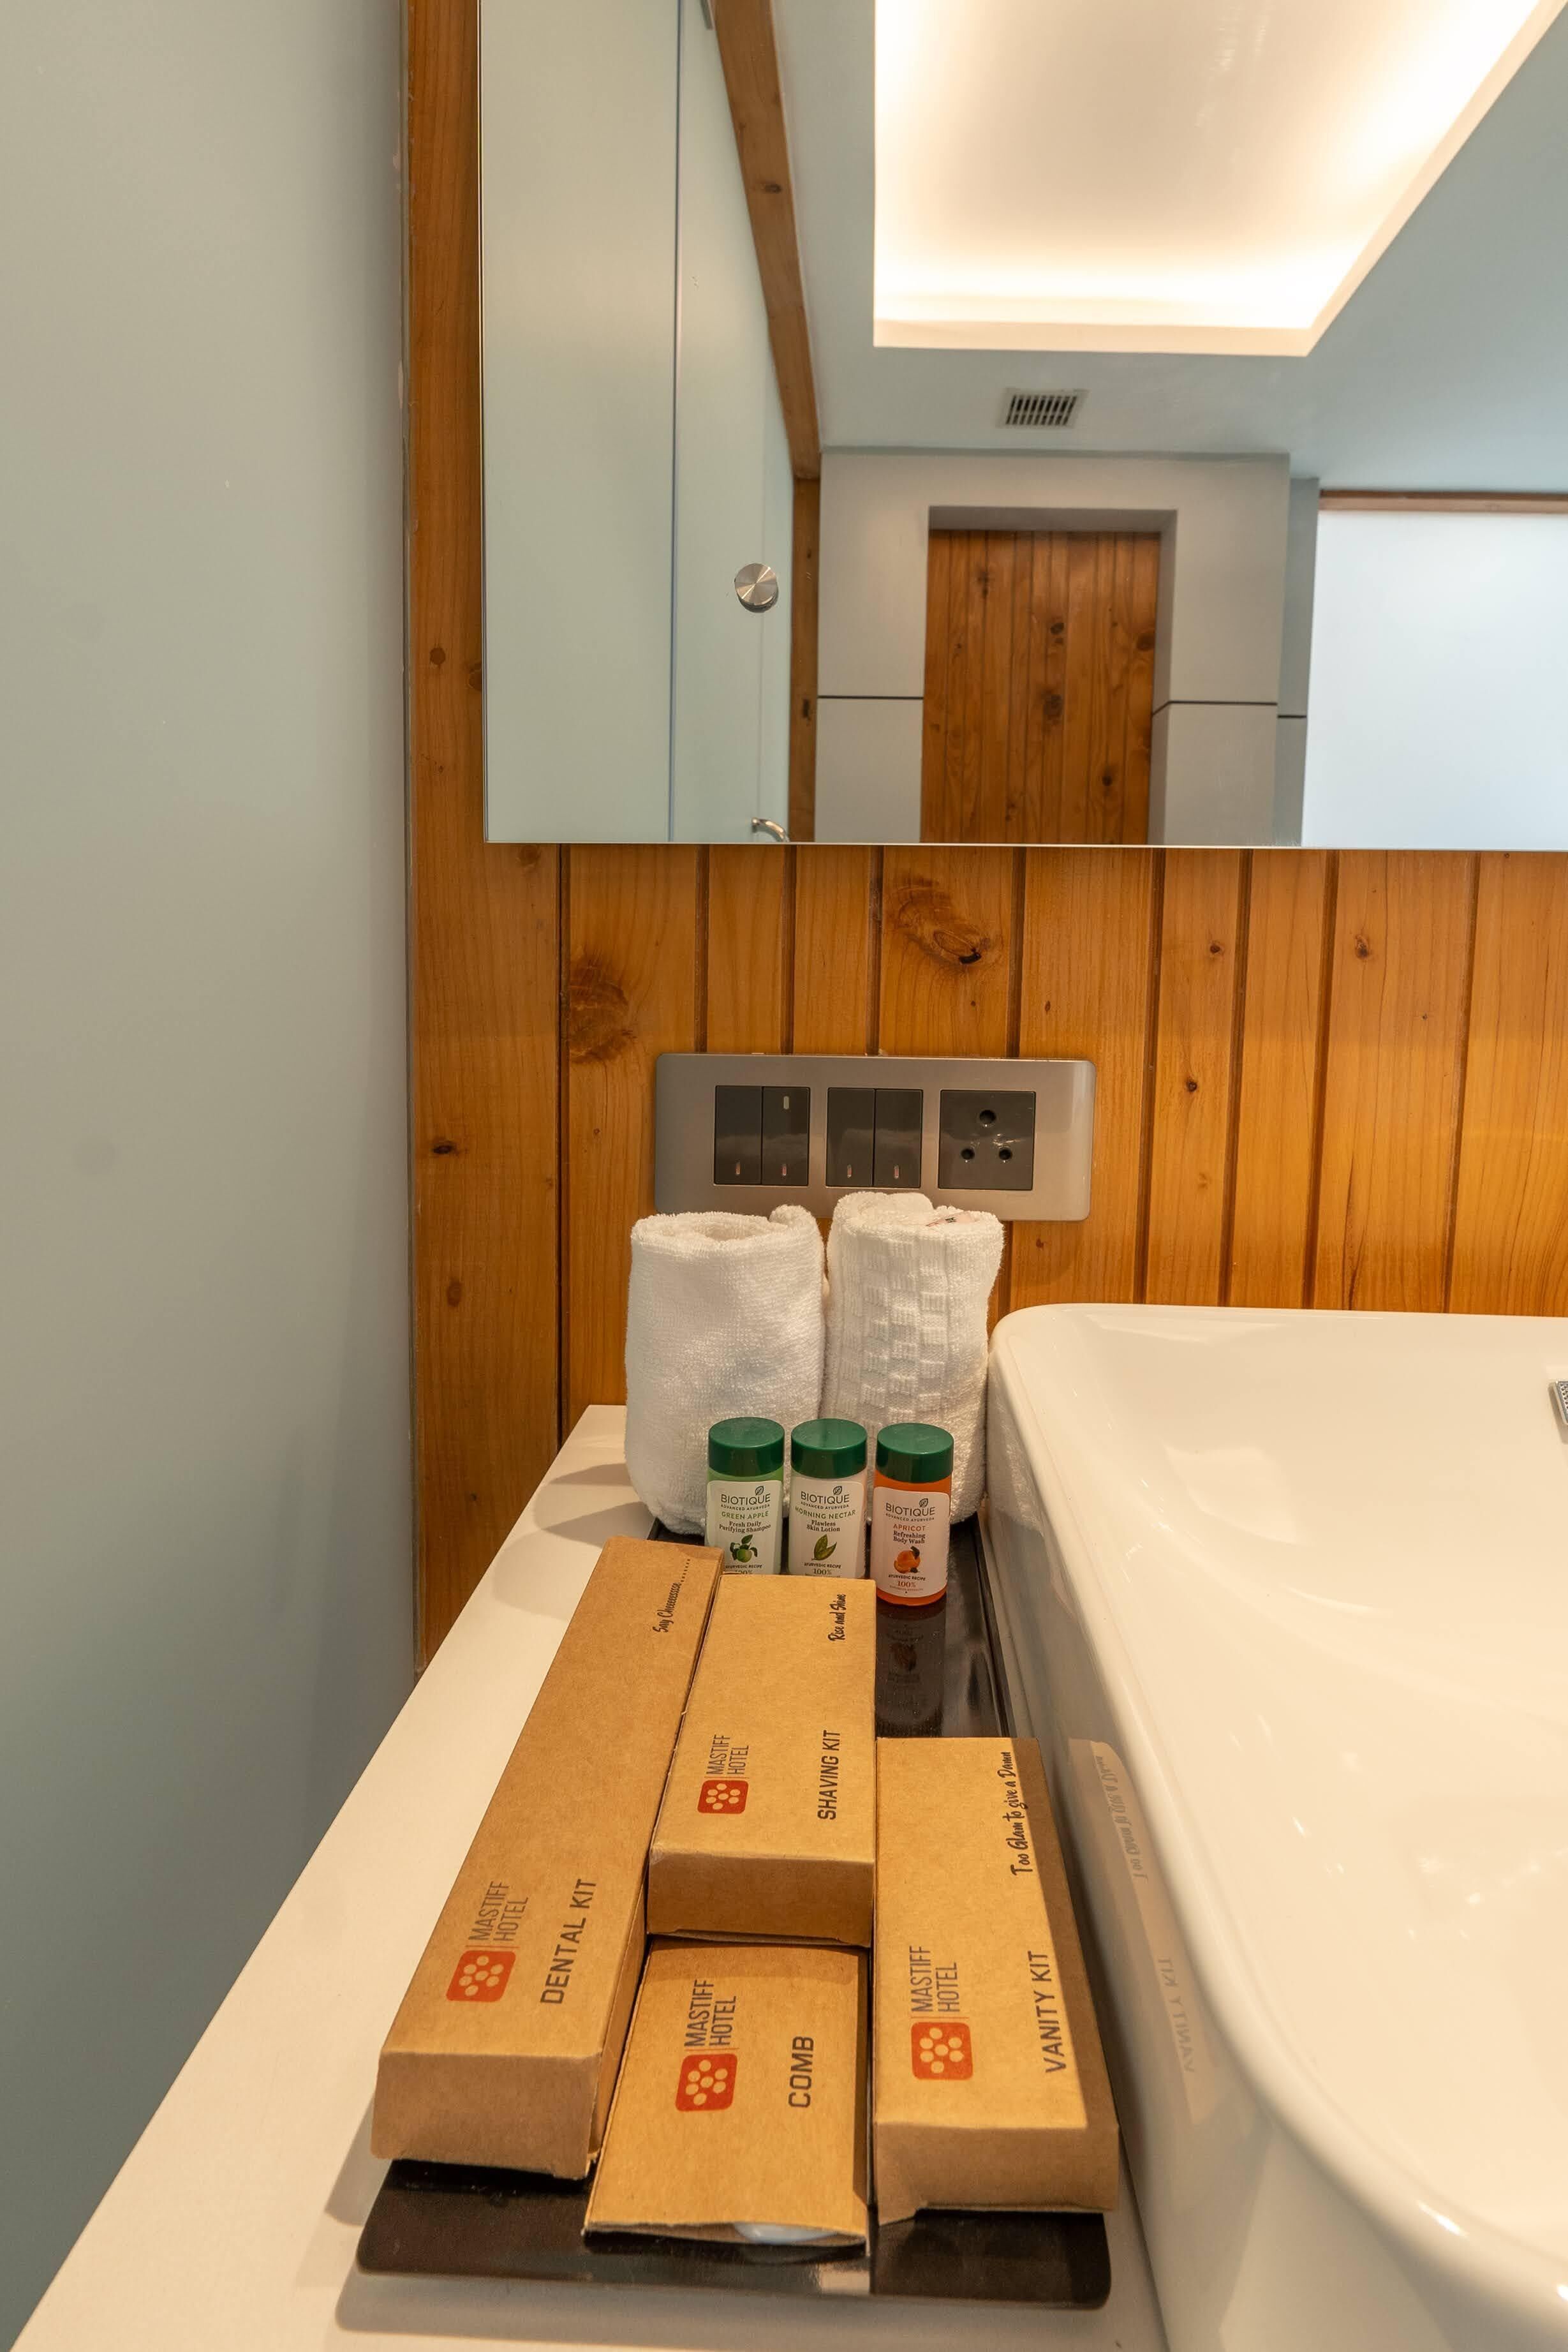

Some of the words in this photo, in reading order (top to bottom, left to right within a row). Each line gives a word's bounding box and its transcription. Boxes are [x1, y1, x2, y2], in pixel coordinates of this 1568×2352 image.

[721, 1494, 771, 1505] BIOTIQUE
[801, 1491, 850, 1505] BIOTIQUE
[801, 1501, 824, 1510] ADVANCED
[721, 1511, 745, 1519] GREEN
[748, 1511, 769, 1519] APPLE
[795, 1507, 826, 1519] MORNING
[829, 1510, 855, 1519] NECTAR
[885, 1503, 935, 1517] BIOTIQUE
[885, 1513, 909, 1521] ADVANCED
[719, 1524, 745, 1533] Purifying
[893, 1530, 926, 1539] Refreshing
[893, 1536, 907, 1544] Body
[829, 1594, 847, 1611] Shine
[652, 1619, 674, 1632] Say
[829, 1612, 845, 1625] and
[827, 1626, 845, 1641] Rise
[822, 1729, 840, 1752] KIT
[706, 1734, 730, 1775] MASTIFF
[727, 1745, 749, 1775] HOTEL
[997, 1752, 1016, 1778] Damn
[817, 1755, 839, 1820] SHAVING
[1003, 1789, 1028, 1810] give
[1002, 1810, 1025, 1822] to
[1006, 1822, 1028, 1850] Glam
[1010, 1853, 1033, 1876] Too
[468, 1881, 509, 1940] MASTIFF
[493, 1896, 528, 1942] HOTEL
[540, 1917, 586, 2004] DENTAL
[569, 1879, 596, 1909] KIT
[1028, 1951, 1052, 1982] KIT
[909, 1946, 933, 2012] MASTIFF
[935, 1962, 960, 2012] HOTEL
[684, 1979, 714, 2047] MASTIFF
[709, 1995, 736, 2046] HOTEL
[1033, 1990, 1067, 2073] VANITY
[788, 2036, 814, 2108] COMB
